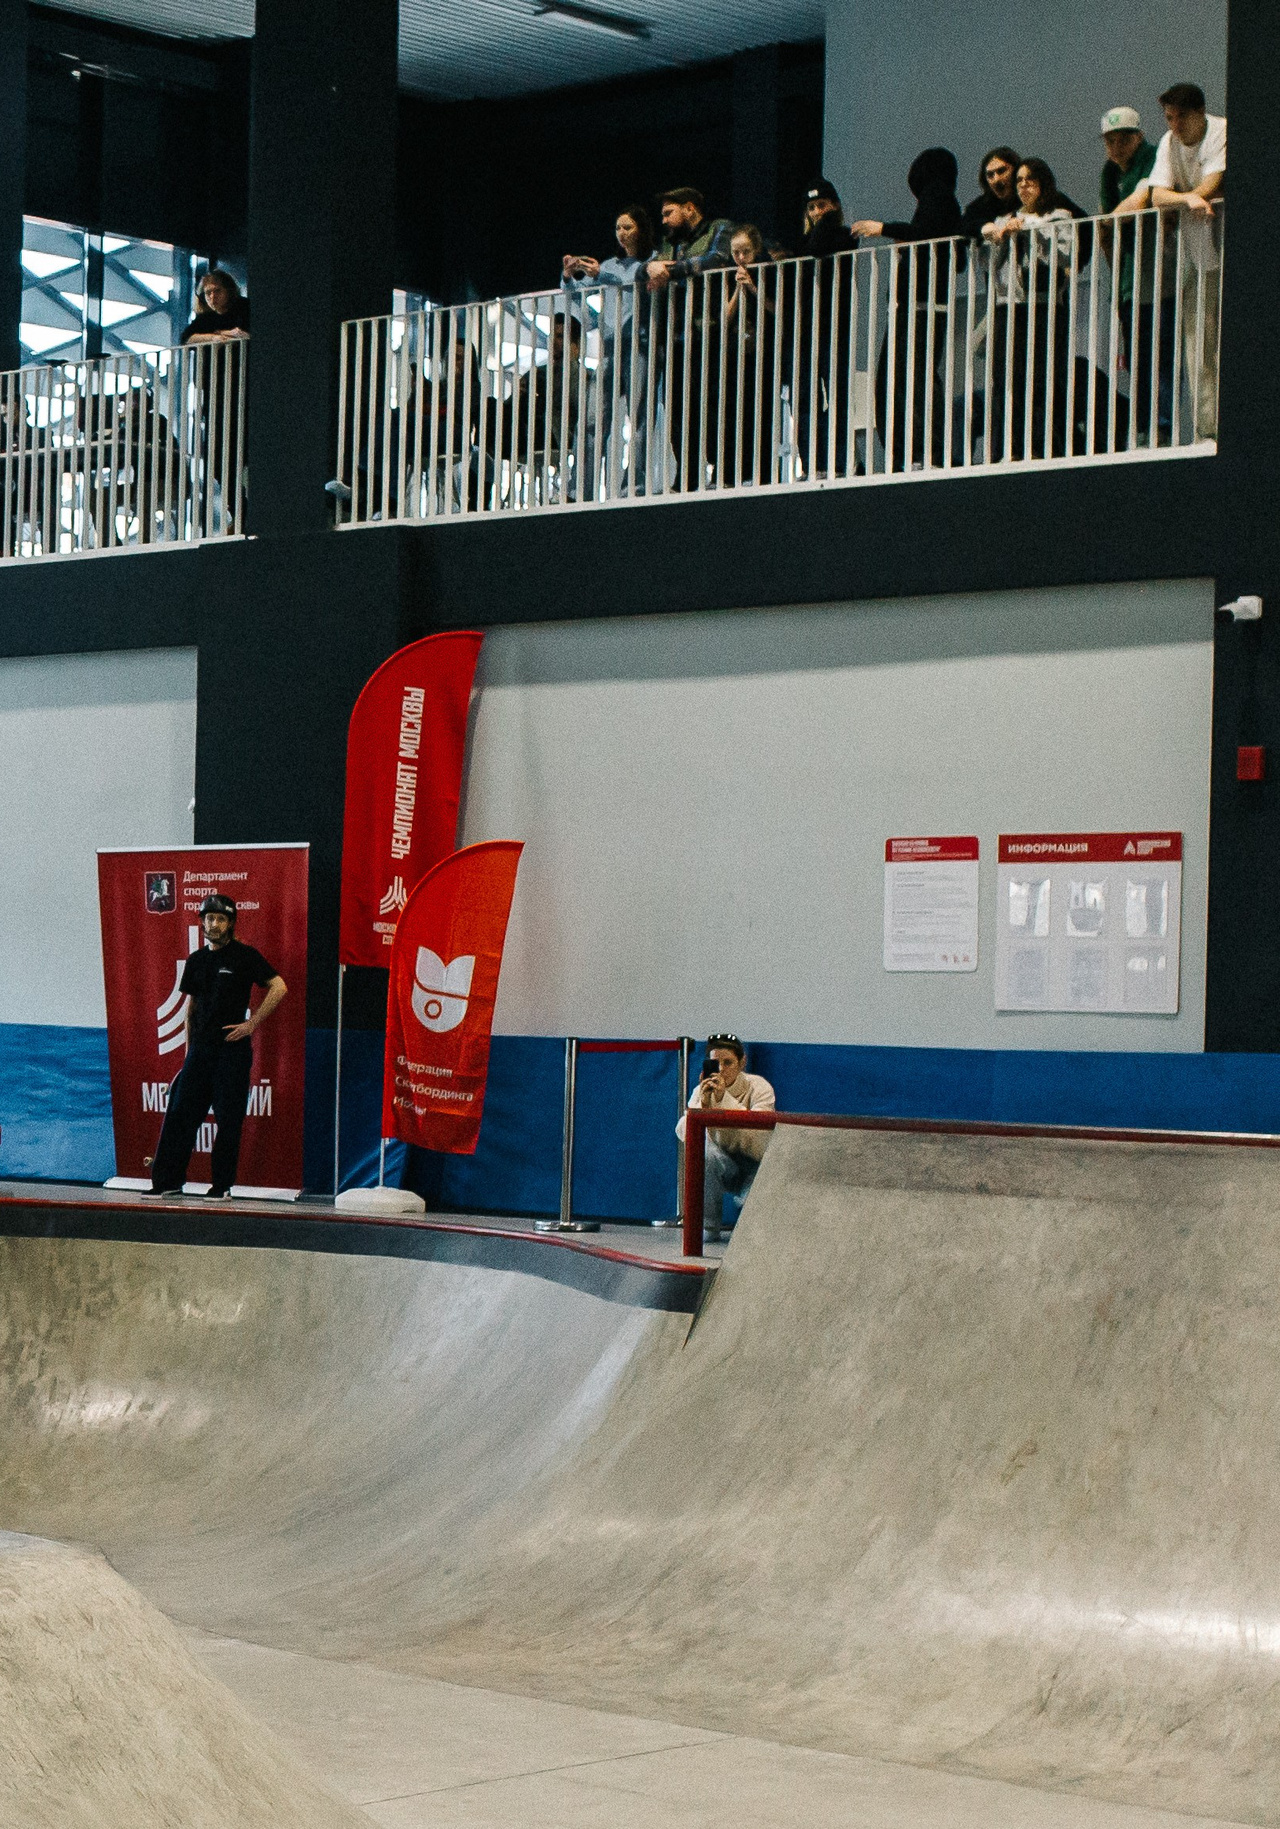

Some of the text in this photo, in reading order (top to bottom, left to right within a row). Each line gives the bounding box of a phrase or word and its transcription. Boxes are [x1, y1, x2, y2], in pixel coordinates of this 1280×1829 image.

[391, 686, 425, 860] ЧЕМПИОНАТ МОСКВЫ
[1007, 843, 1089, 854] ИНФОРМАЦИЯ
[183, 871, 248, 883] Департамент
[183, 887, 218, 897] спорта
